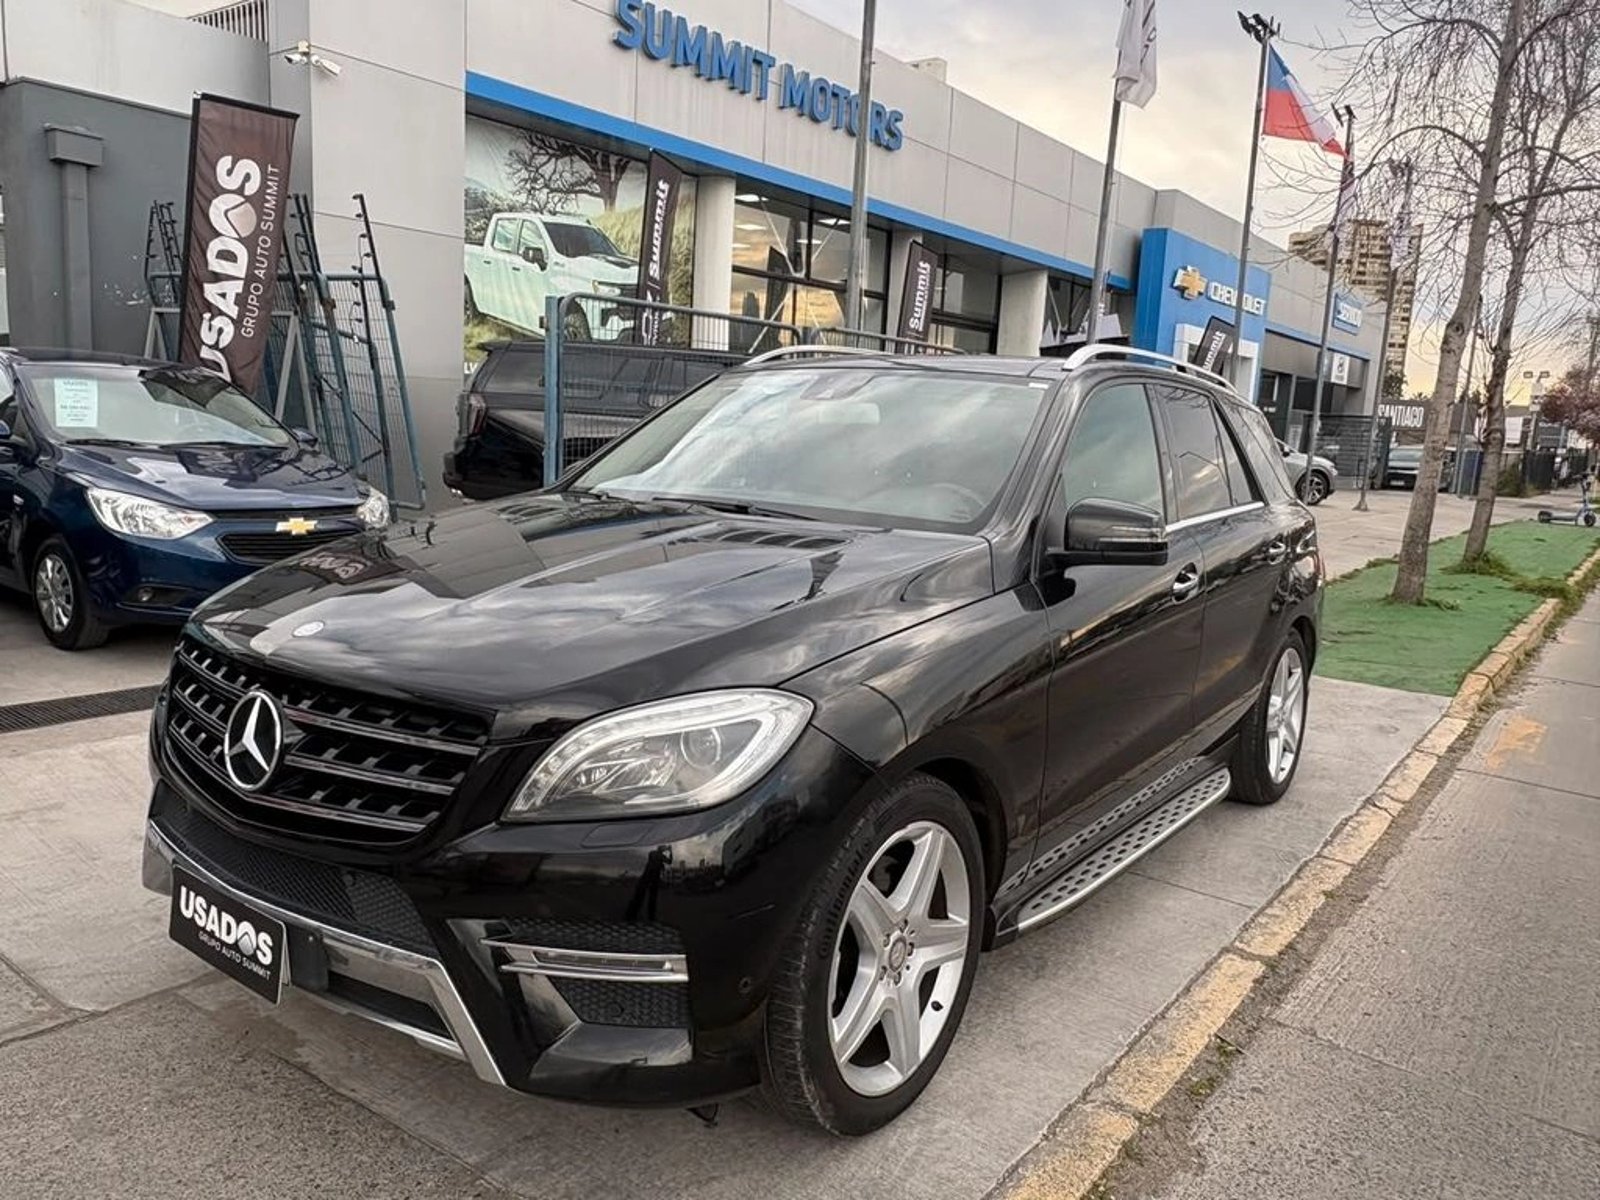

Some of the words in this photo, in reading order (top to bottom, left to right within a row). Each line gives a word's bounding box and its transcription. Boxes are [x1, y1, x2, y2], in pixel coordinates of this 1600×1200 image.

[613, 0, 776, 101] SUMMIT
[260, 163, 280, 232] SUMMIT
[649, 179, 670, 281] Summit
[254, 235, 272, 280] AUTO
[241, 282, 264, 338] GRUPO
[909, 261, 931, 332] Summit
[180, 885, 273, 966] USADOS
[221, 946, 241, 963] AUTO
[242, 957, 271, 980] SUMMIT
